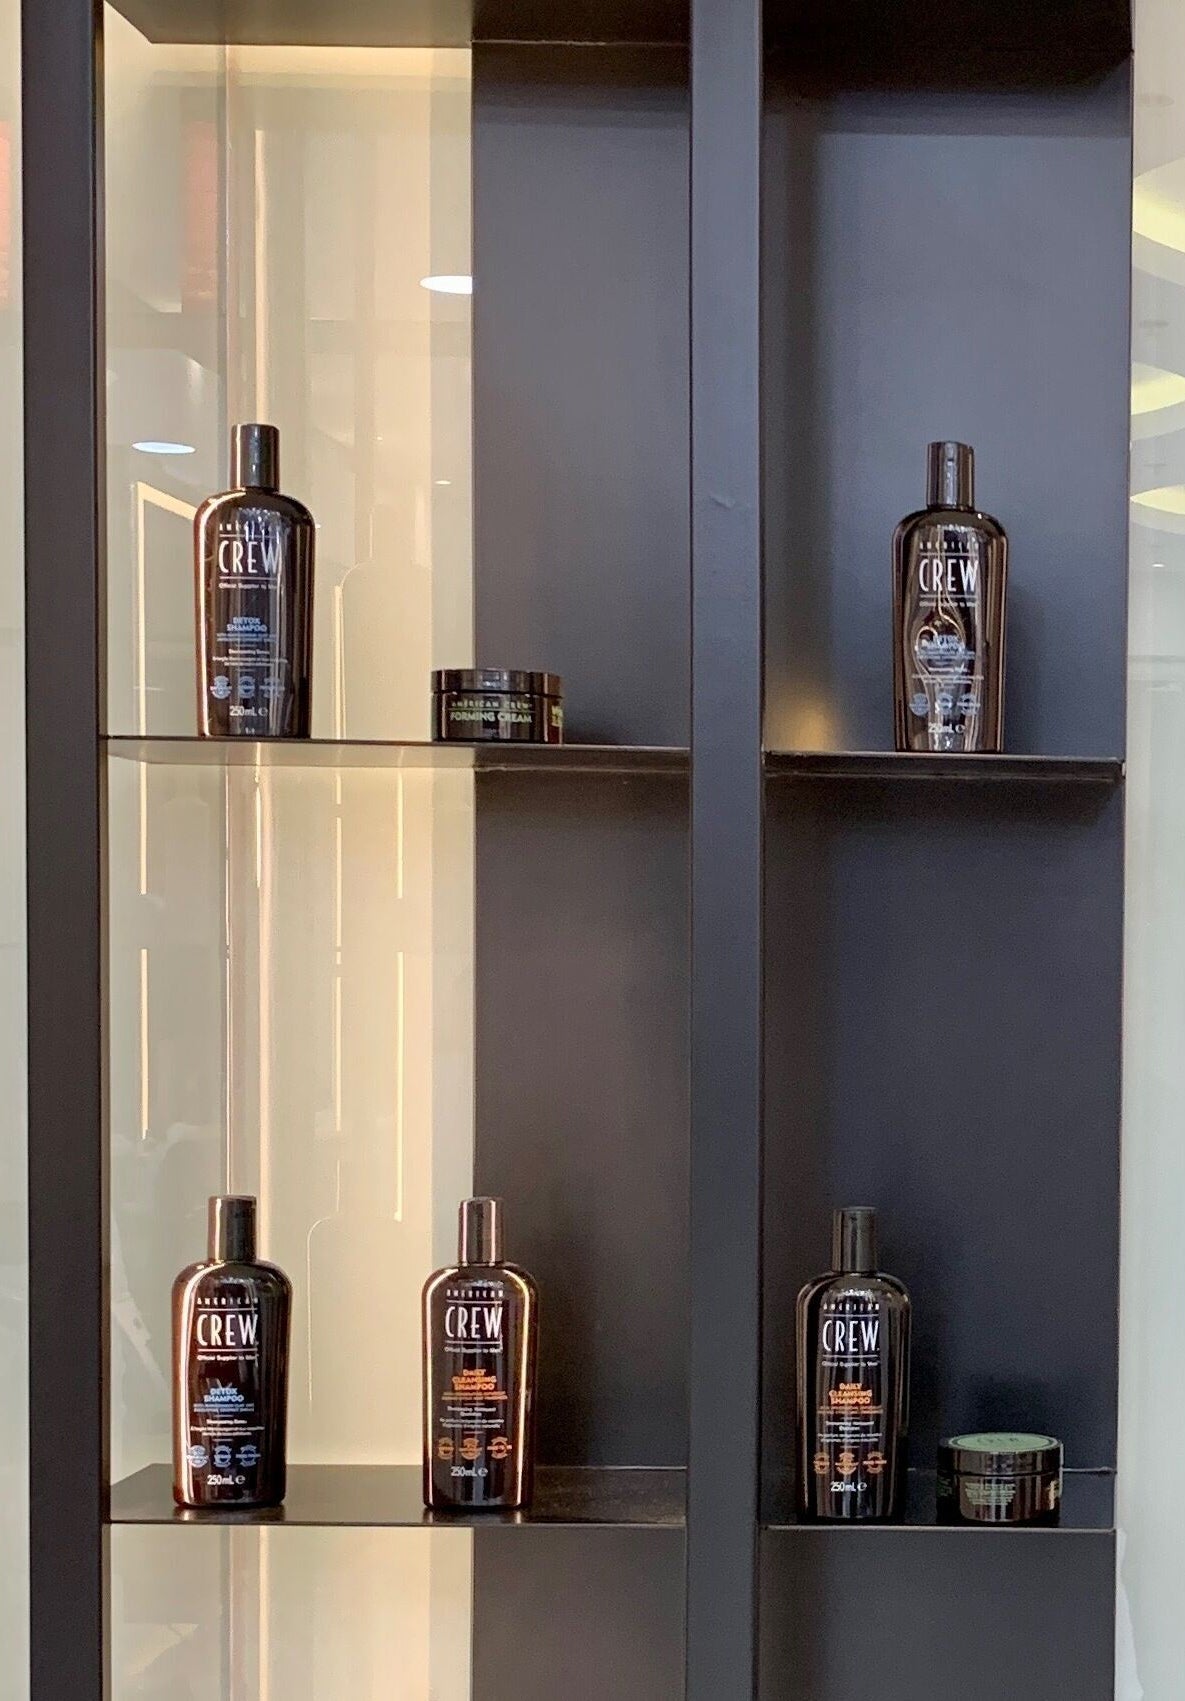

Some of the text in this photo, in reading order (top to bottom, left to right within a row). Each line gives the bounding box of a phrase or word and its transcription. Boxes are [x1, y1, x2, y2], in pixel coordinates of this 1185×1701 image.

[918, 559, 980, 592] CREW
[450, 711, 533, 723] FORMING CREAM
[445, 1306, 503, 1338] CREW
[196, 1314, 259, 1346] CREW
[209, 1387, 239, 1395] DETOX
[203, 1394, 245, 1403] SHAMPOO
[206, 1474, 235, 1485] 250mL
[830, 1481, 857, 1492] 250mL
